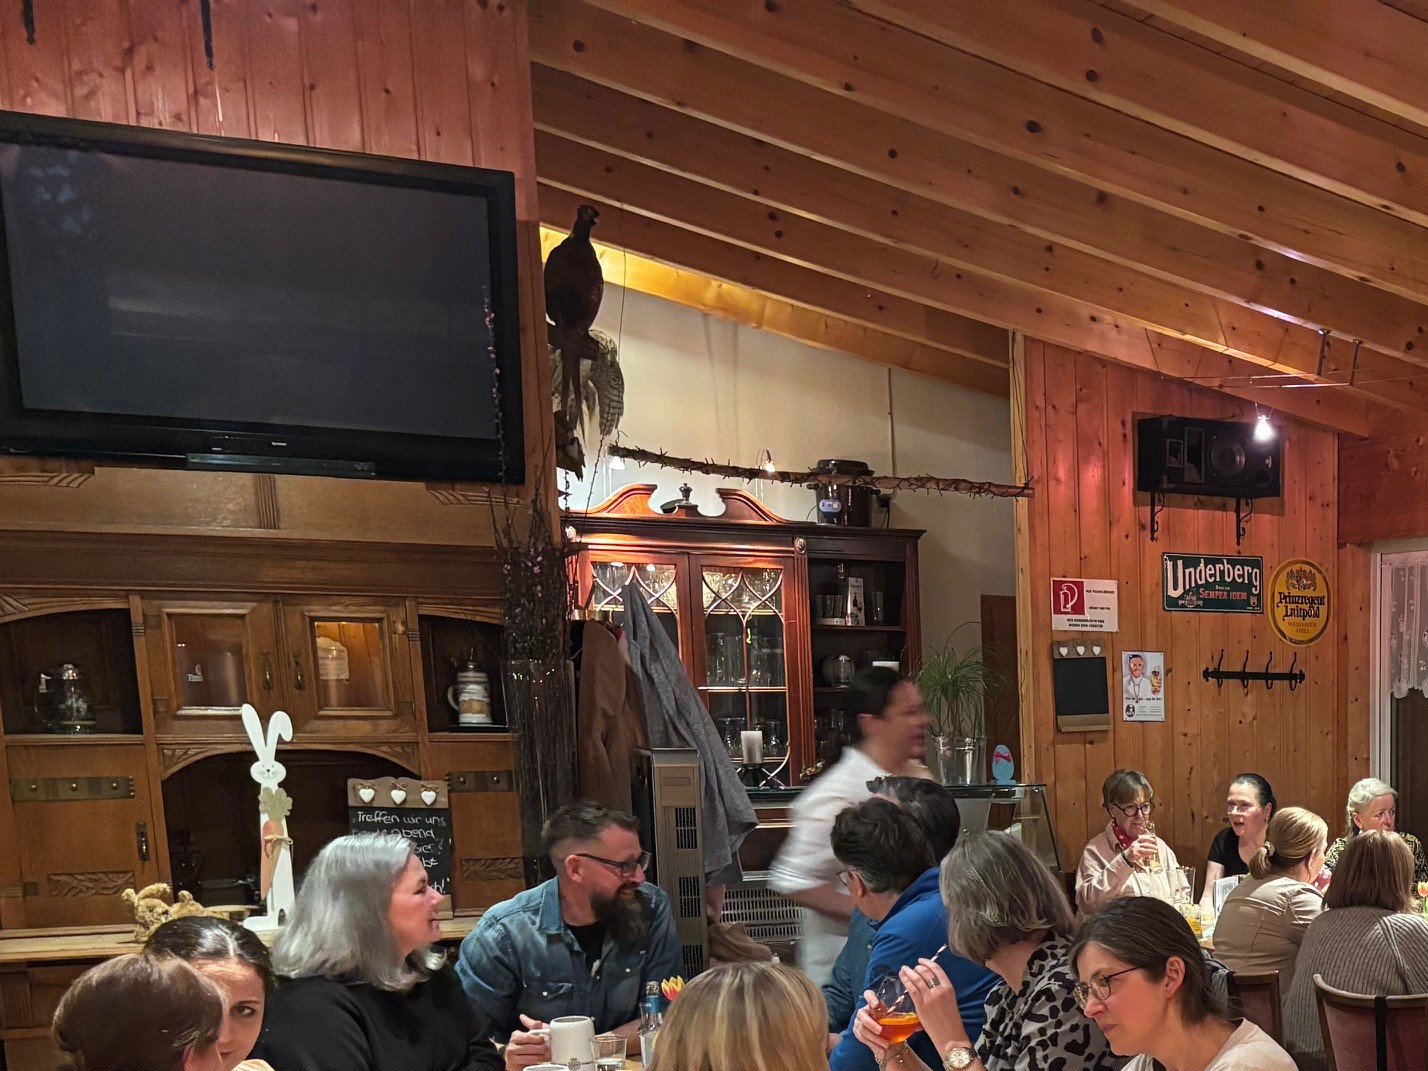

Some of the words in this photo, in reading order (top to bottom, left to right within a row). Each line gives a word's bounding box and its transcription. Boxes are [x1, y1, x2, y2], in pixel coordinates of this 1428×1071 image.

[1166, 558, 1260, 598] Underberg
[1276, 591, 1326, 608] Prinzregent
[1282, 604, 1320, 621] Luitpold
[357, 811, 400, 824] Treffen
[403, 816, 422, 824] wir
